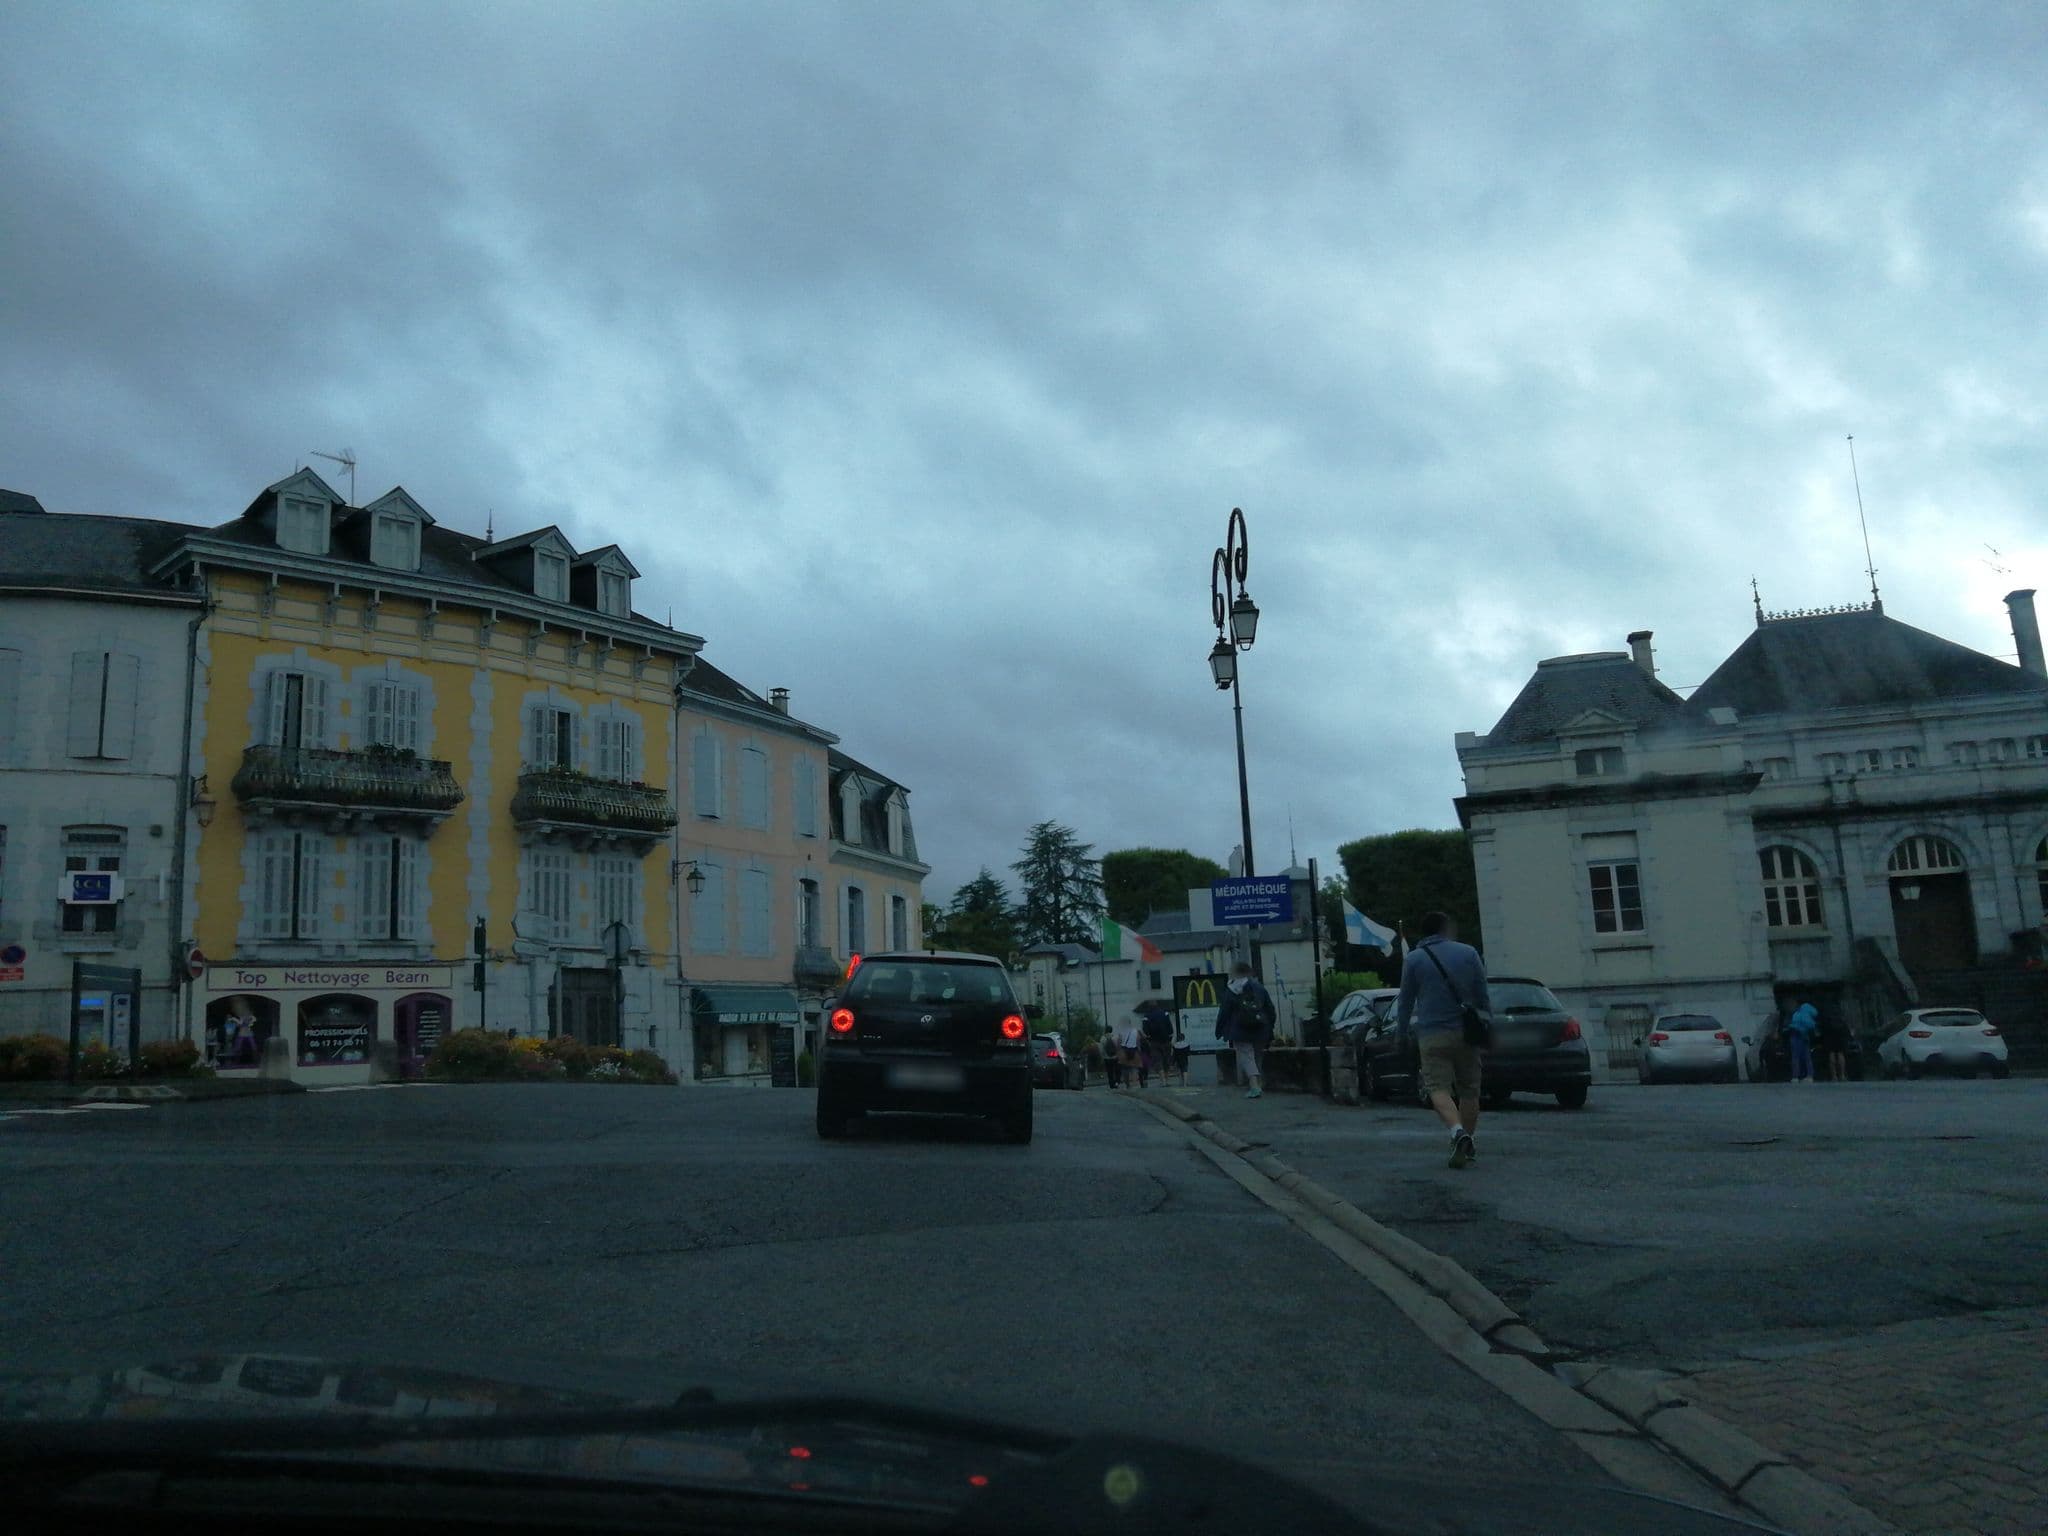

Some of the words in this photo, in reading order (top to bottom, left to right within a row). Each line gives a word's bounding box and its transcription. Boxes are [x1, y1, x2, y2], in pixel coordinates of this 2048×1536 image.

[236, 970, 268, 986] Top
[284, 970, 370, 988] Nettoyage
[385, 970, 430, 983] Bearn
